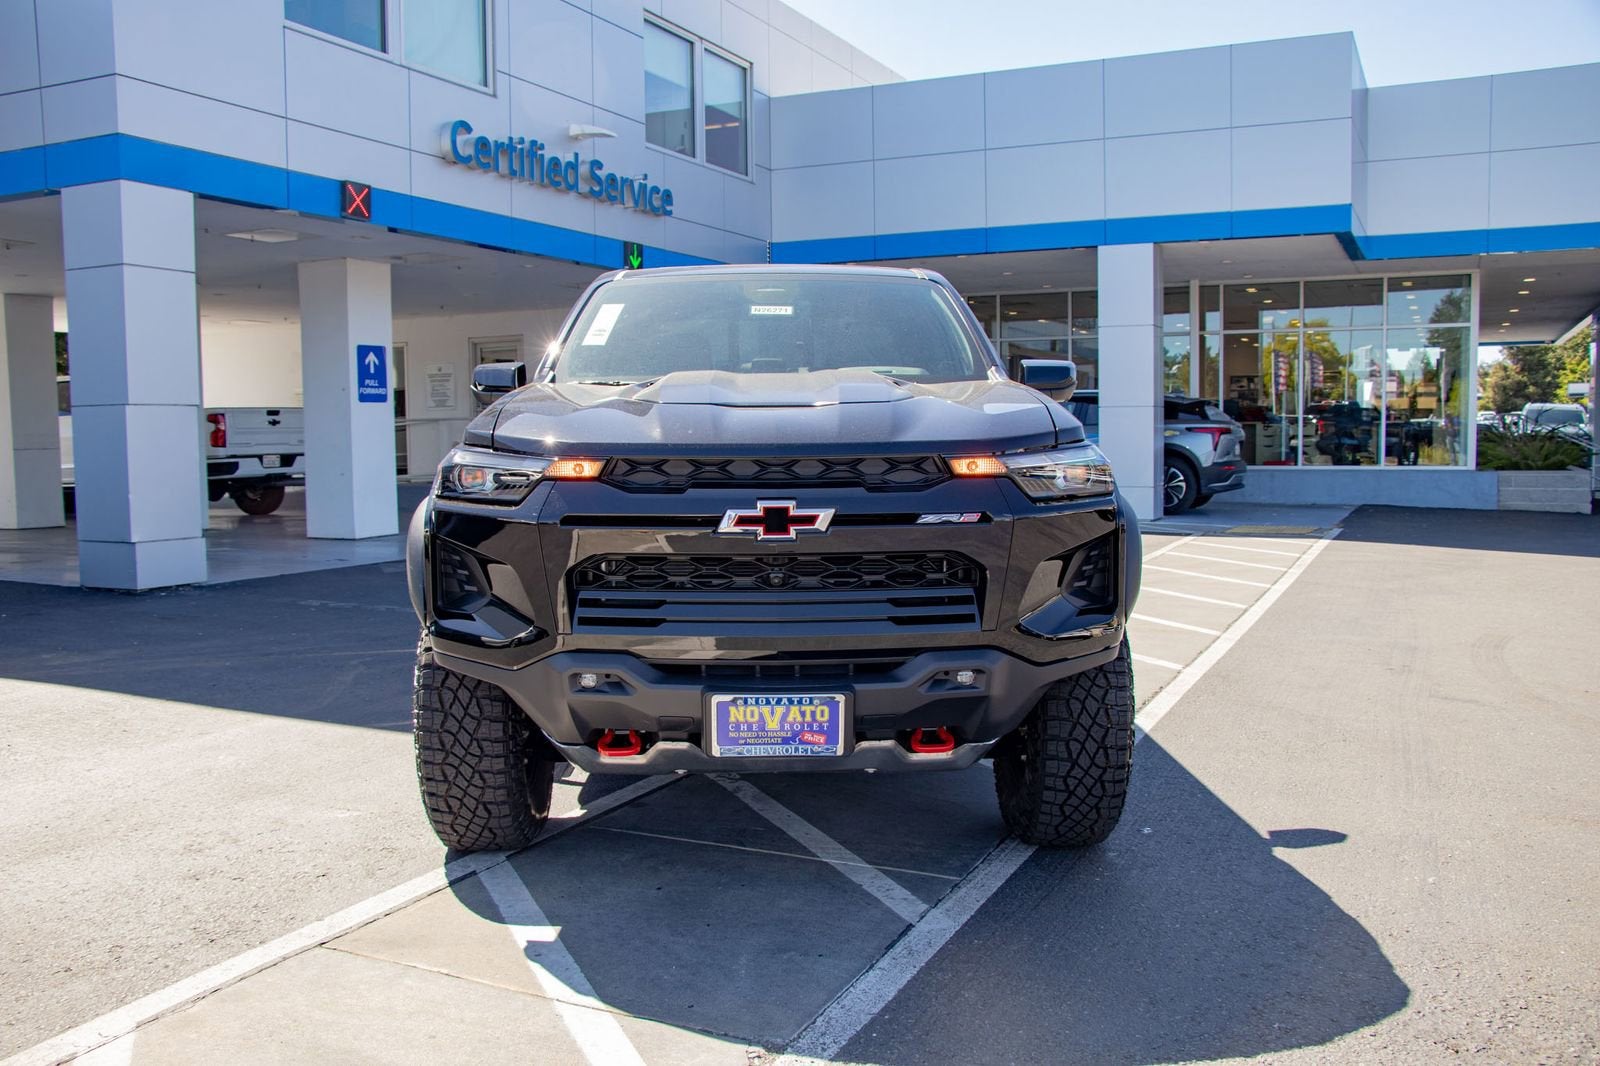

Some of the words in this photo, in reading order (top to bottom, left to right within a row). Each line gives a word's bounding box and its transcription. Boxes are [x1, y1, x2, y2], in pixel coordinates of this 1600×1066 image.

[450, 119, 579, 194] Certified
[588, 158, 674, 217] Service
[359, 387, 387, 395] FORWARD
[915, 512, 982, 524] ZR2
[747, 697, 811, 705] NOVATO
[728, 705, 830, 730] NOVATO
[743, 745, 812, 756] CHEVROLET
